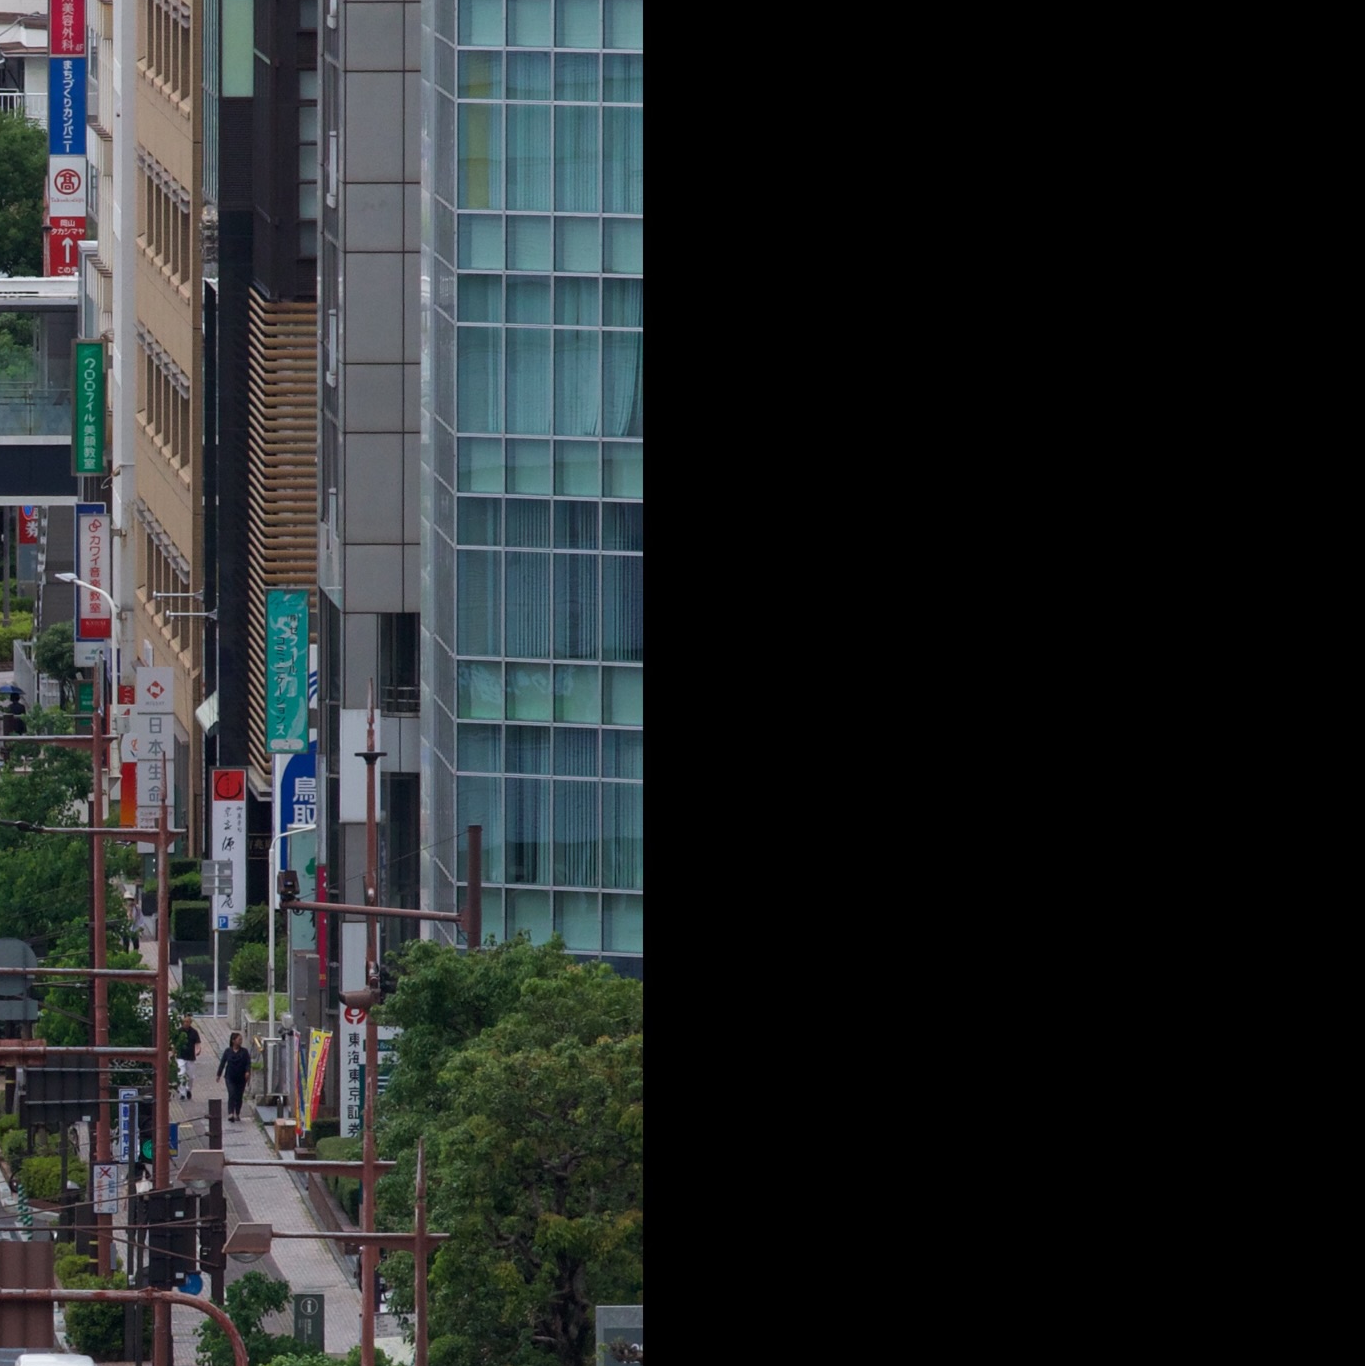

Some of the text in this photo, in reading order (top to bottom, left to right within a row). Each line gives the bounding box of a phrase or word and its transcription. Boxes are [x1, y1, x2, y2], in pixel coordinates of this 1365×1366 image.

[62, 60, 74, 153] まちづくりカンパニー
[50, 227, 85, 235] タカシマヤ
[88, 536, 101, 614] カワイ音楽教室
[148, 717, 165, 803] 日本生命
[292, 777, 316, 825] 鳥取
[219, 917, 227, 928] P
[347, 1032, 361, 1137] 東海東京証券
